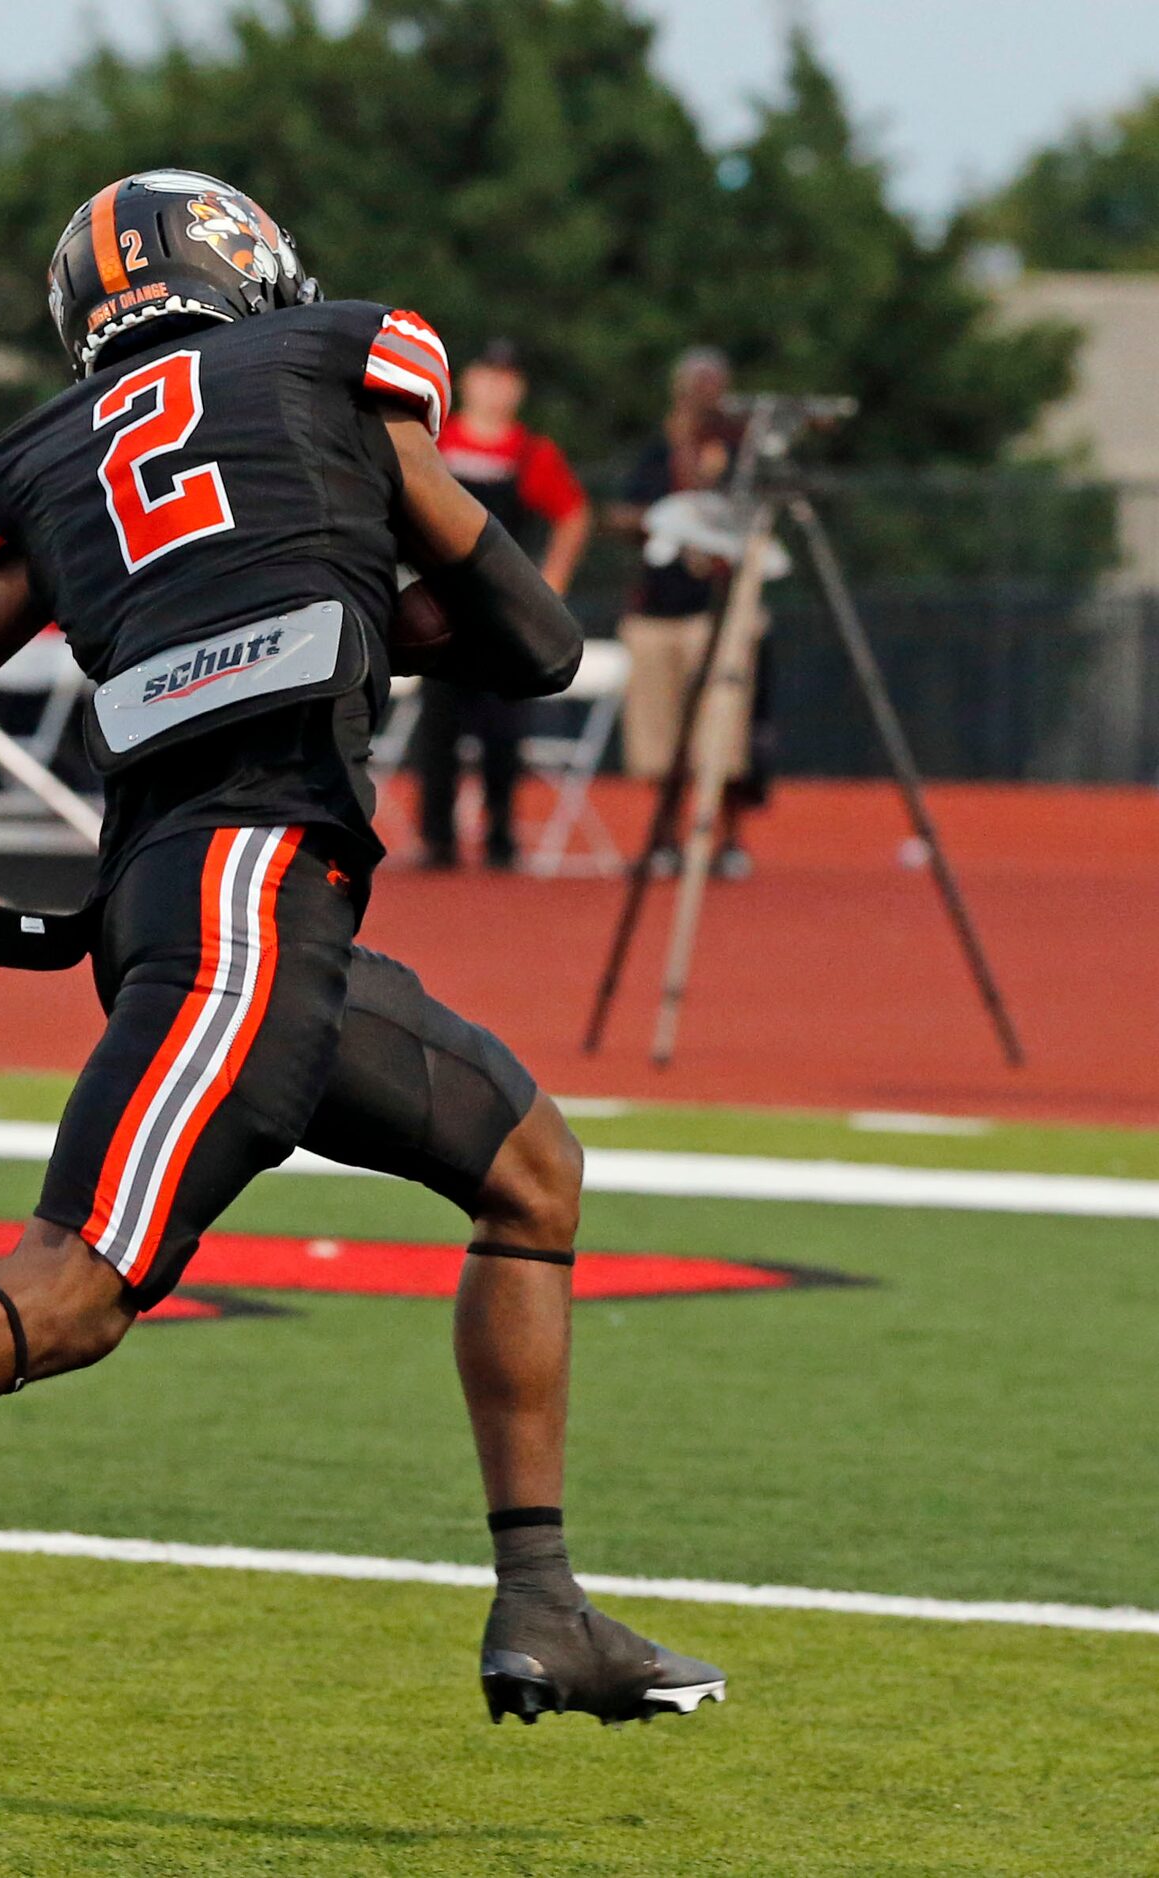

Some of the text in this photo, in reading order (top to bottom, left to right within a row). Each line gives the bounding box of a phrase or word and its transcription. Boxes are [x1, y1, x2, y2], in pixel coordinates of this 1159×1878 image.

[119, 229, 149, 272] 2
[119, 282, 170, 310] ORANGE
[92, 349, 235, 576] 2
[142, 628, 285, 703] schutt
